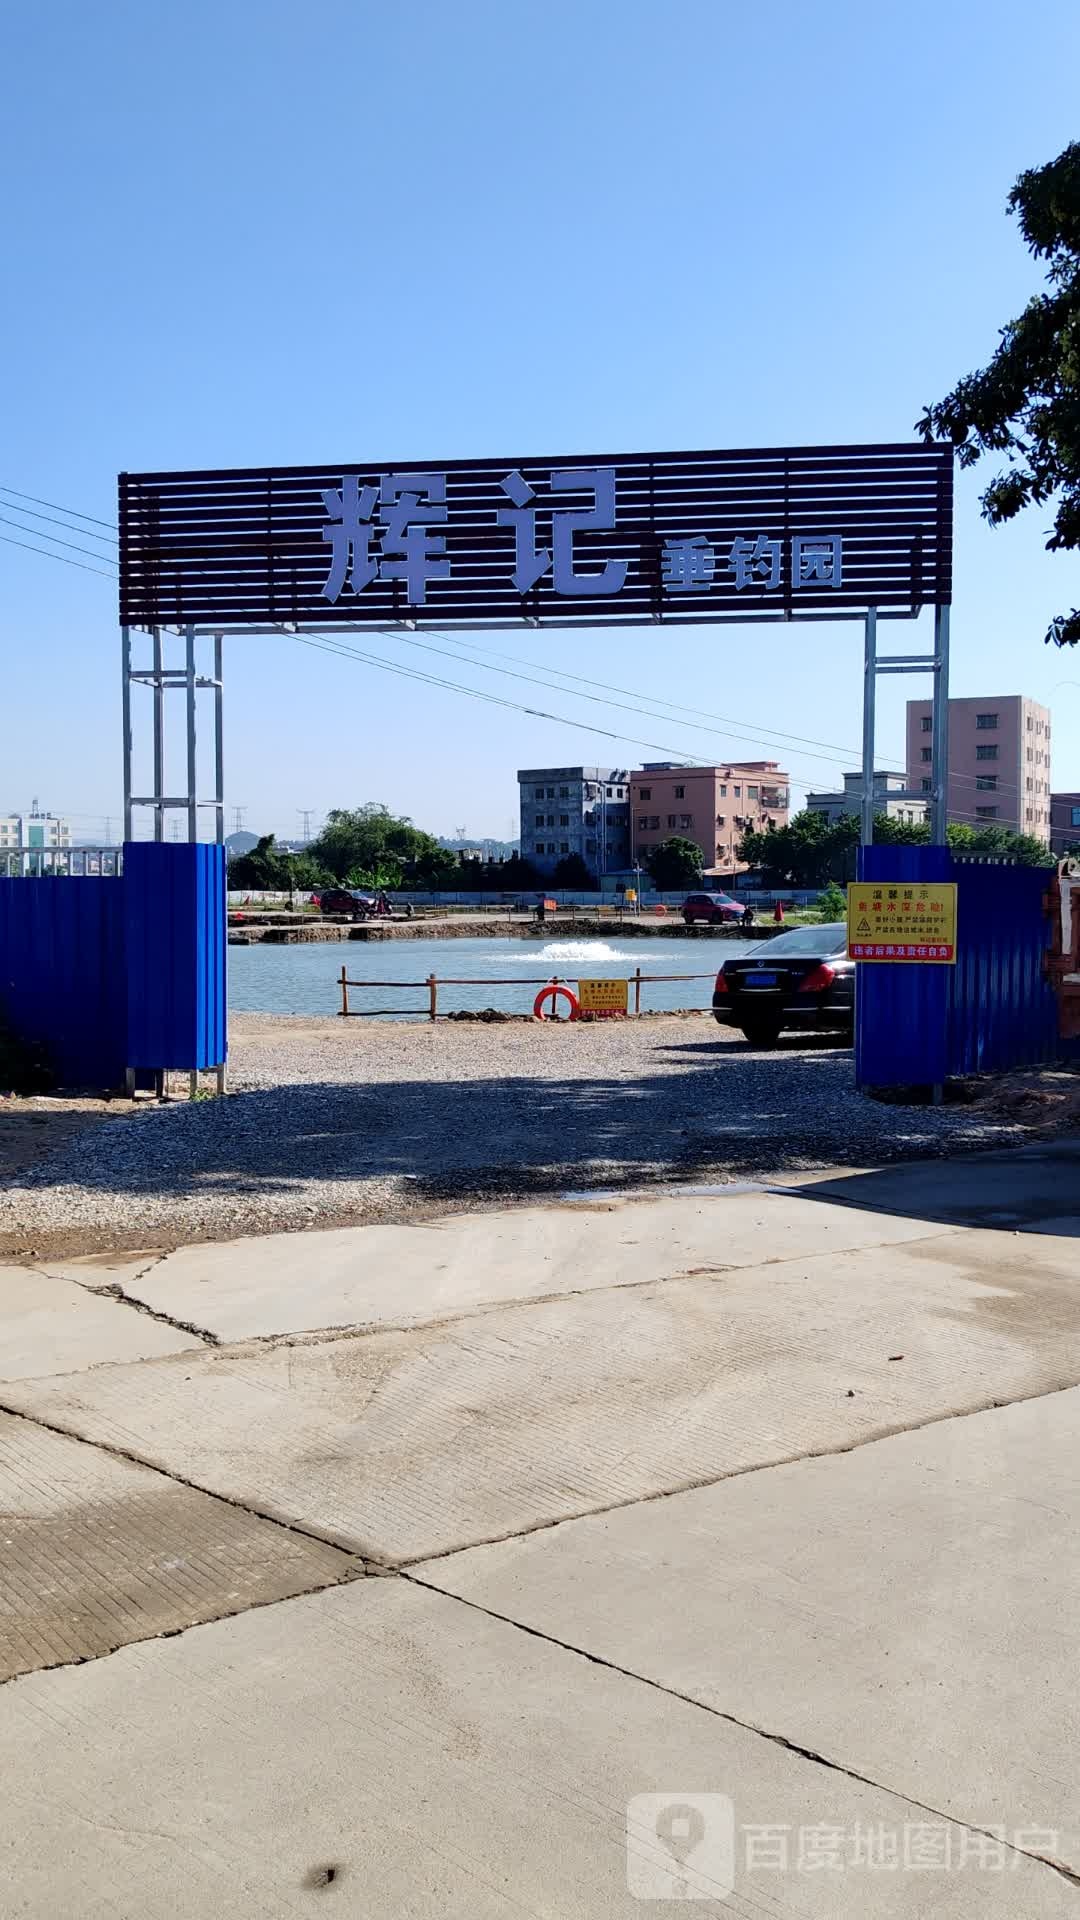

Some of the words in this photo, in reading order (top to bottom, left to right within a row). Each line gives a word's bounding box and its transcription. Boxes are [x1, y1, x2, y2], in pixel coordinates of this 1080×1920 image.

[320, 469, 628, 604] 辉记
[660, 534, 843, 592] 垂钓园
[873, 889, 929, 900] 温馨提示
[854, 946, 948, 956] 违者后果及责任自负
